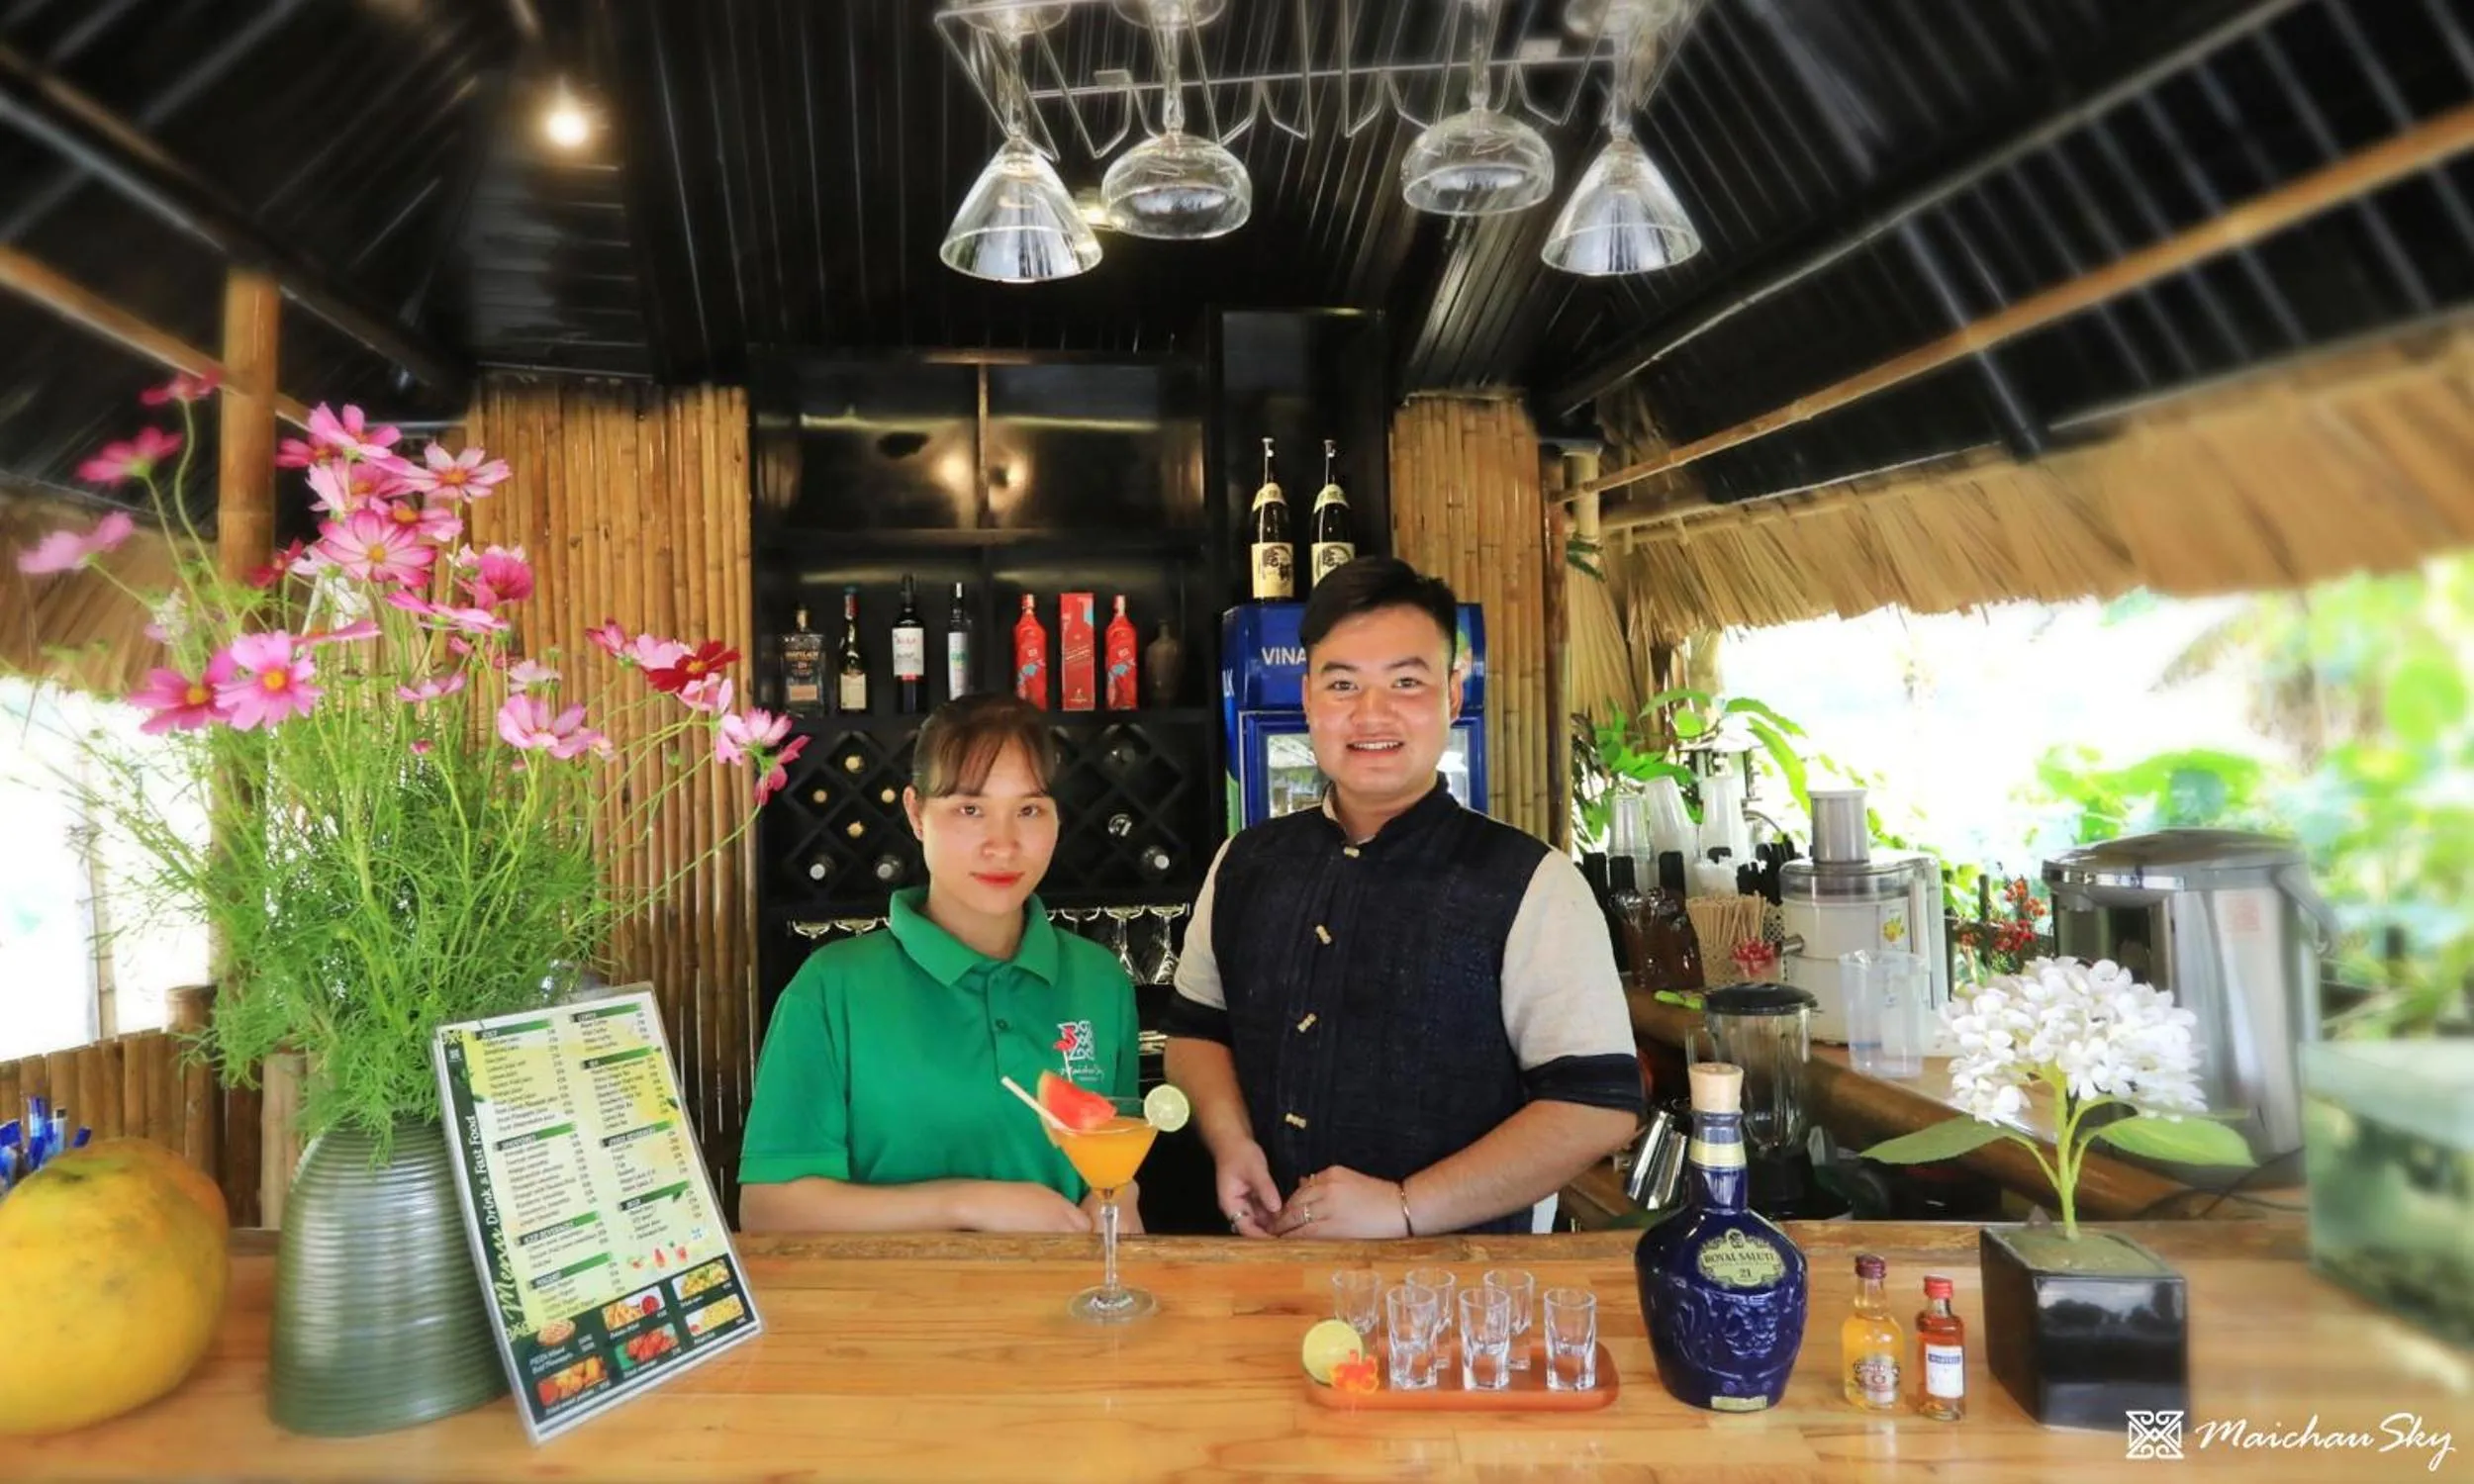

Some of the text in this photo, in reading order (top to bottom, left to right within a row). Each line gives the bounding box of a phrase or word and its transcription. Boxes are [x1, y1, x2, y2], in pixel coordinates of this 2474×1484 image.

[465, 1115, 481, 1146] Food
[473, 1148, 487, 1174] Fast
[481, 1188, 499, 1225] Drink
[1703, 1252, 1737, 1264] ROYAL
[1739, 1267, 1752, 1278] 21
